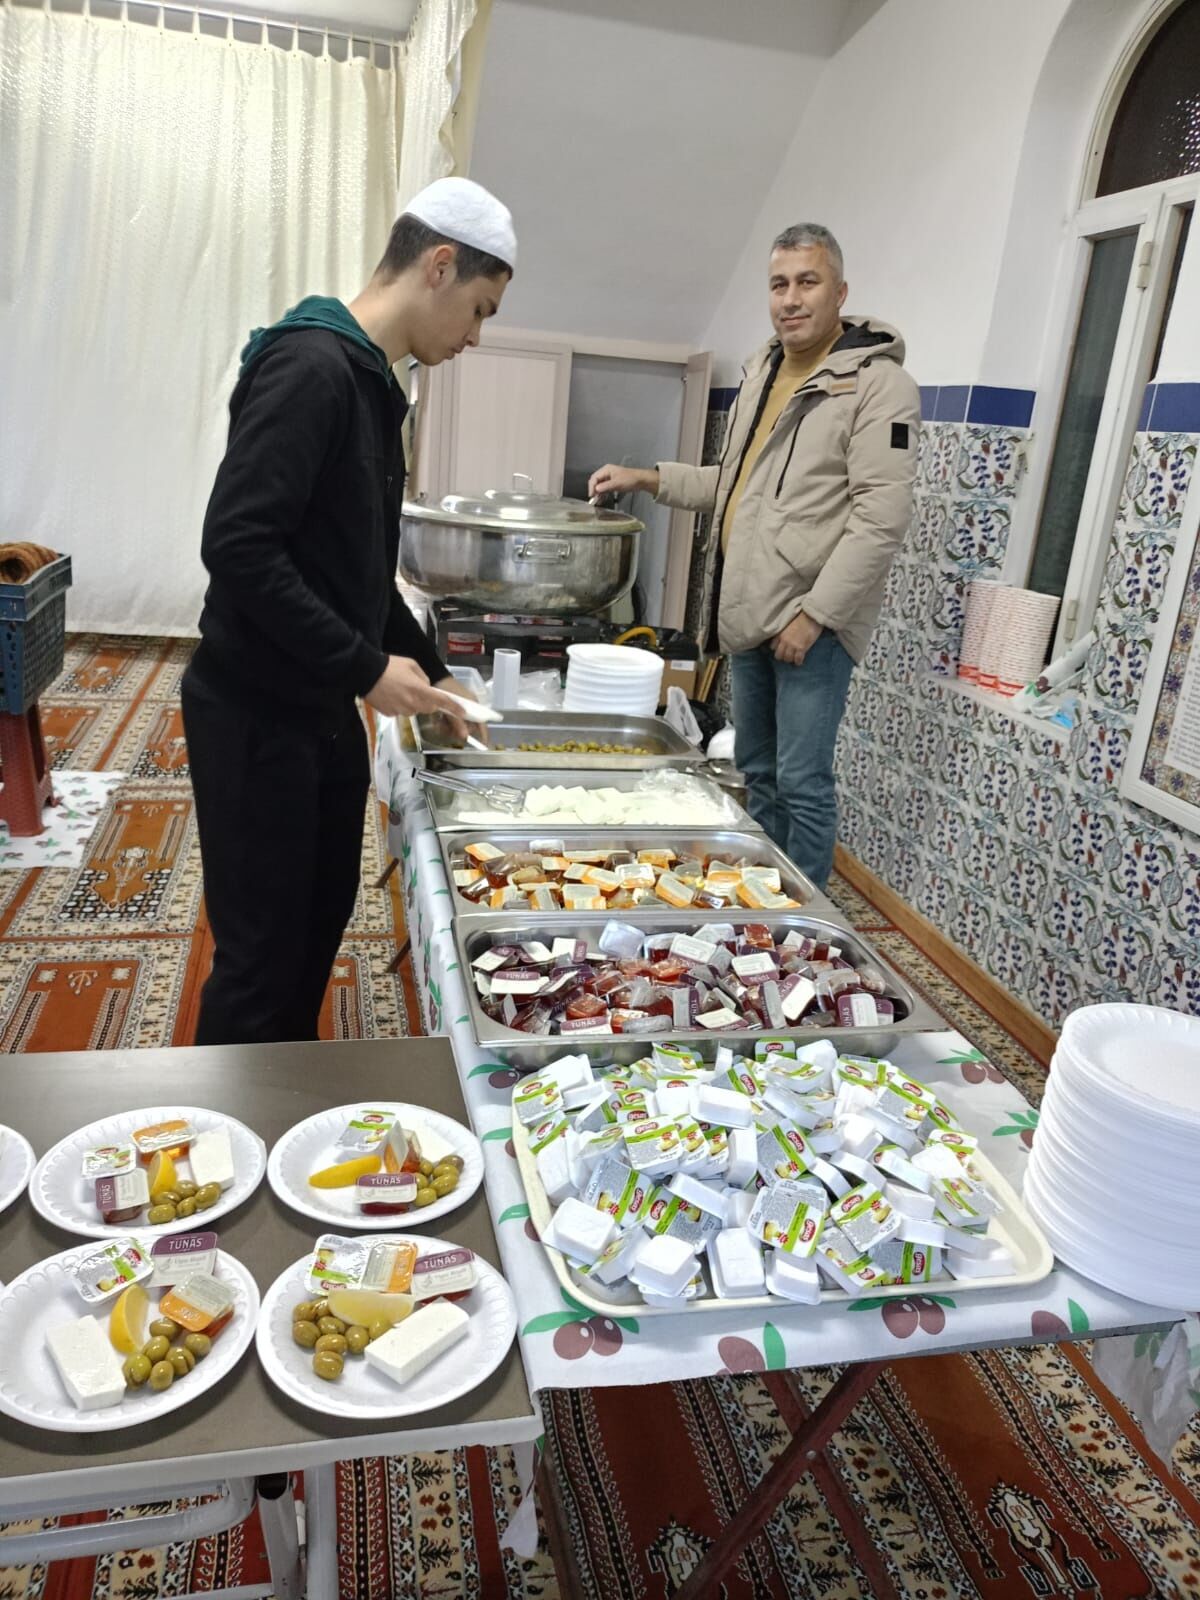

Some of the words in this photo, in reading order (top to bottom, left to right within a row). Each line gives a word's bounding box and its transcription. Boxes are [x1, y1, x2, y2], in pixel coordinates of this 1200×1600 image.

[842, 1007, 851, 1026] UNAS
[371, 1175, 400, 1184] TUNAS
[168, 1237, 202, 1250] TUNAS
[423, 1253, 457, 1269] TUNAS
